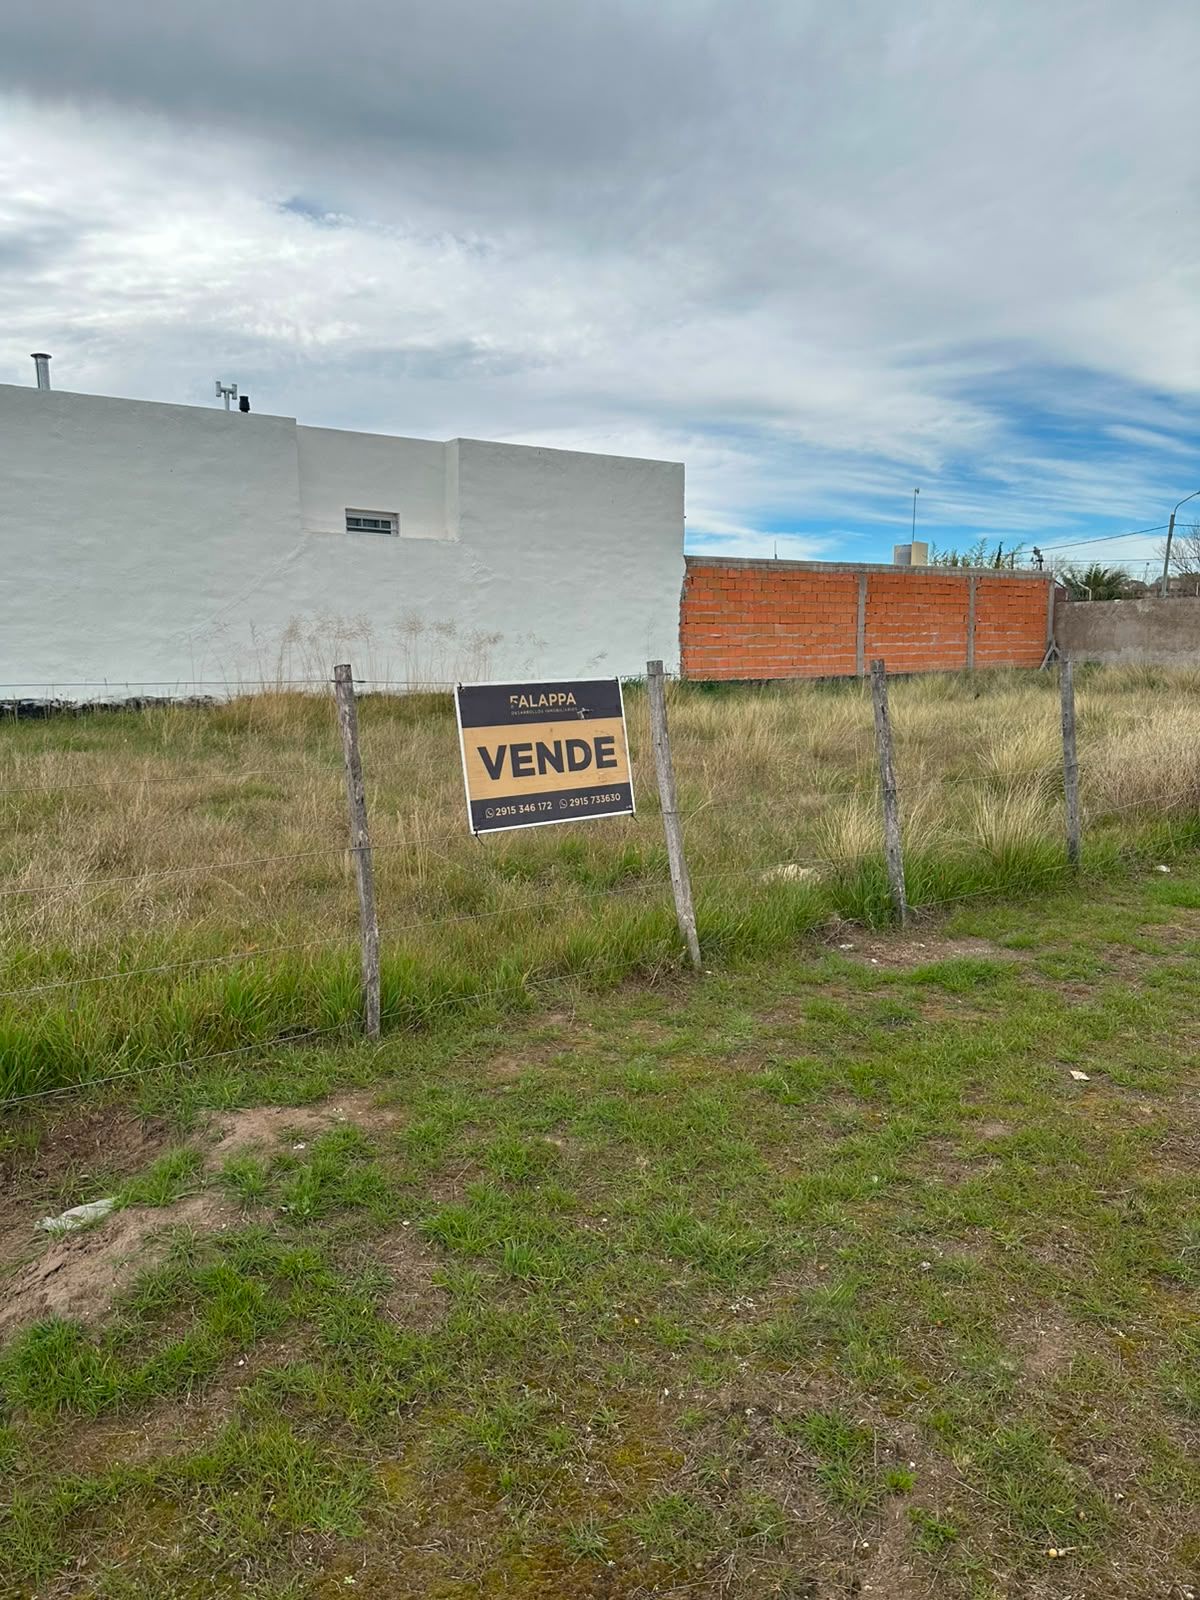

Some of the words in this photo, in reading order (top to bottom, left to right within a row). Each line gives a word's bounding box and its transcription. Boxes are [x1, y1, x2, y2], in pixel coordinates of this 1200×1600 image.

[509, 692, 577, 709] FALAPPA
[477, 736, 618, 780] VENDE
[569, 797, 589, 807] 2915
[591, 792, 621, 804] 733630
[495, 807, 517, 817] 2915
[519, 804, 536, 814] 346
[538, 801, 553, 811] 172
